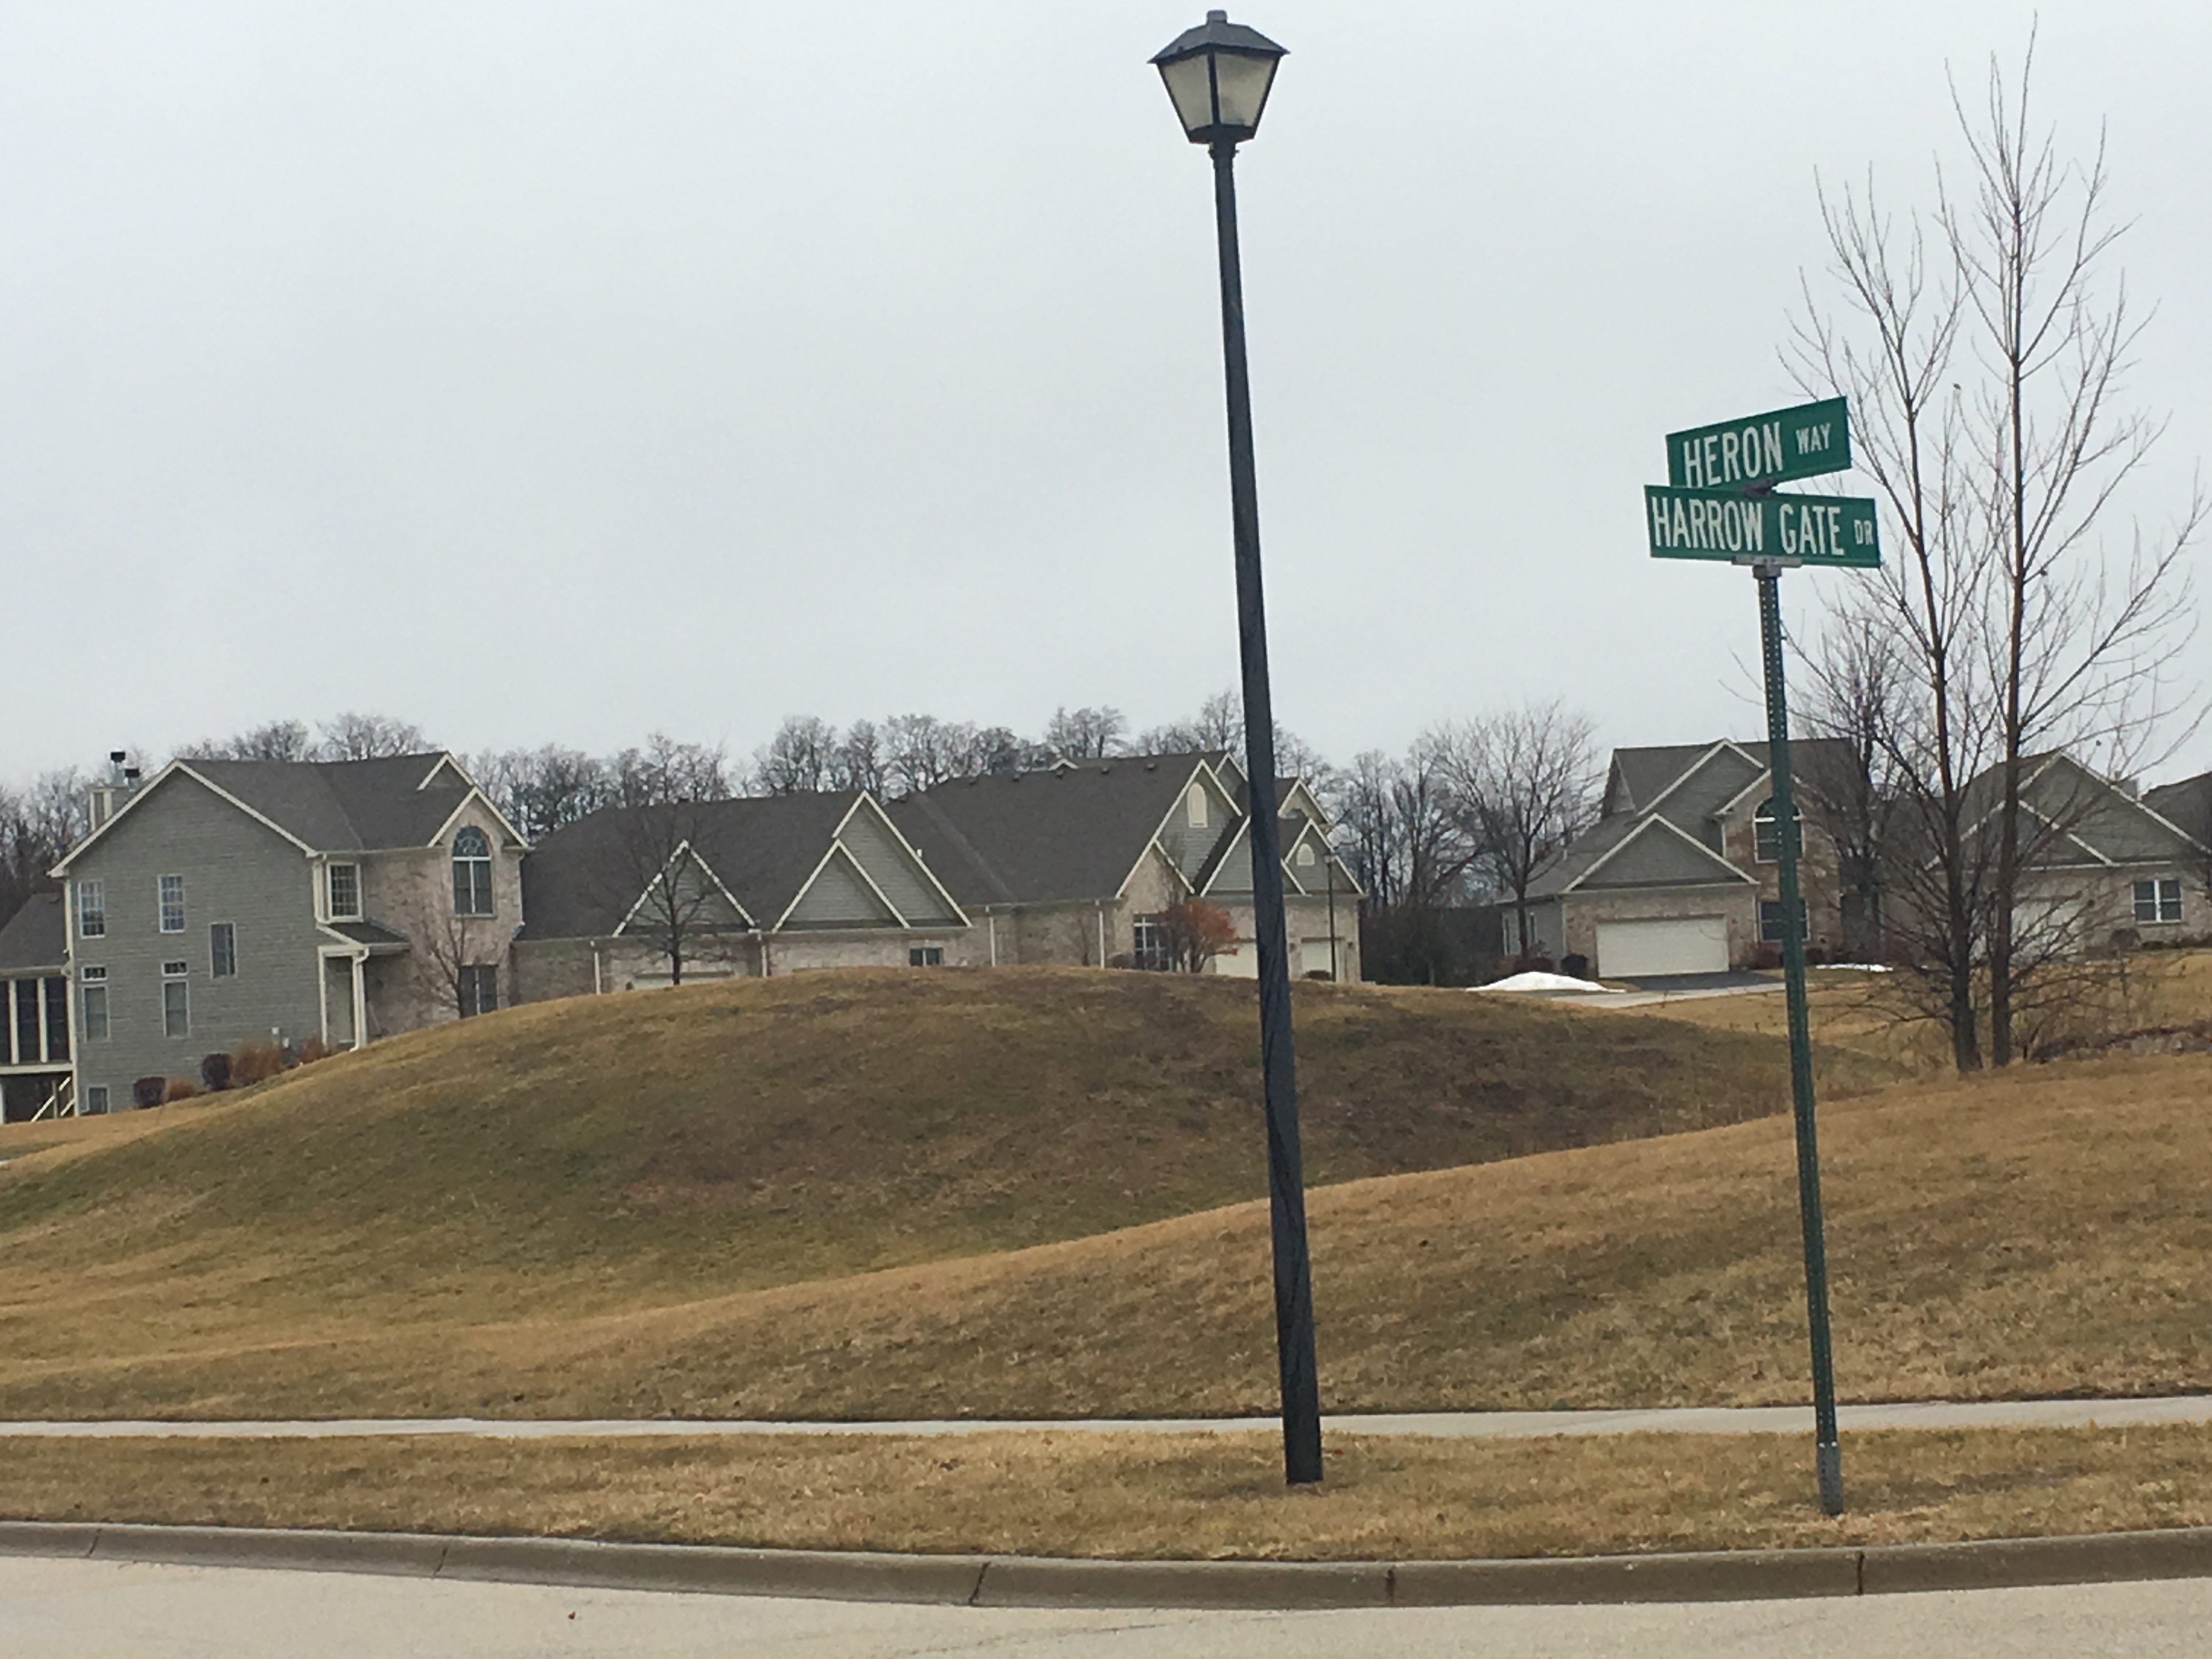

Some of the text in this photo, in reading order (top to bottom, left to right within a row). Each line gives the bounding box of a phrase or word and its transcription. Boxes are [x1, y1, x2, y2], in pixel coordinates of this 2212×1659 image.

[1683, 421, 1832, 488] HERON WAY
[1651, 496, 1875, 556] HARROW GATE DR
